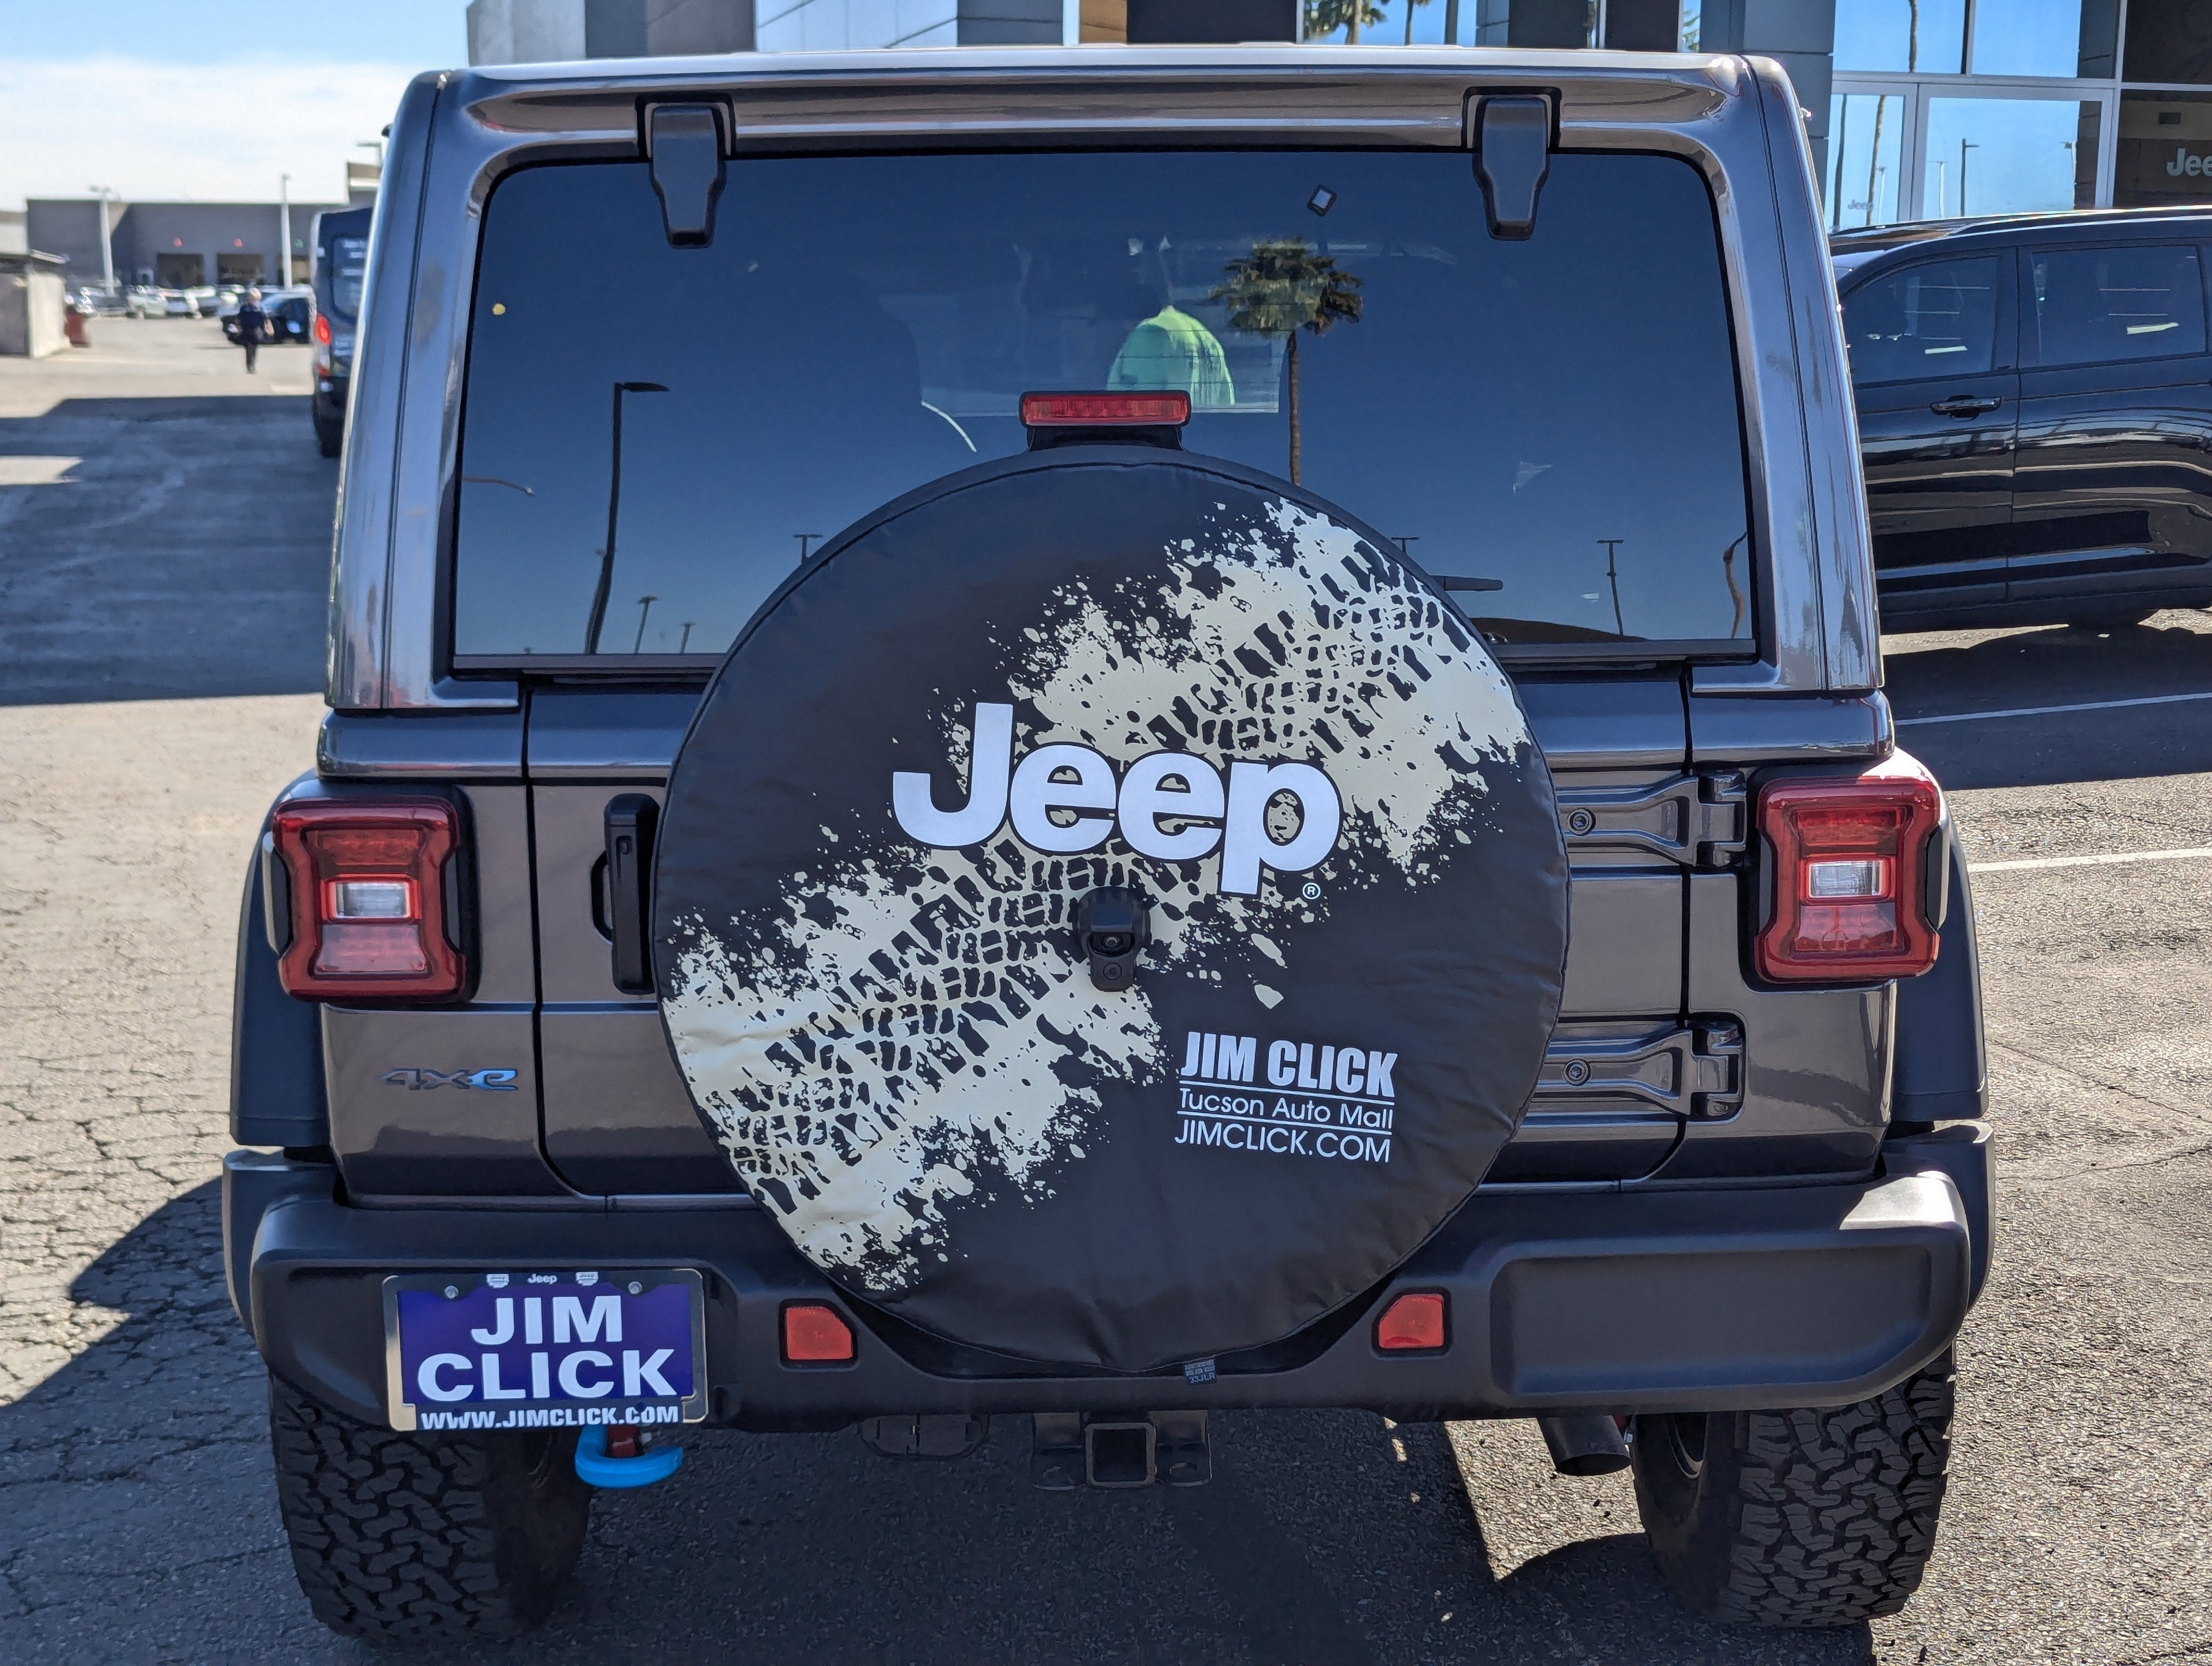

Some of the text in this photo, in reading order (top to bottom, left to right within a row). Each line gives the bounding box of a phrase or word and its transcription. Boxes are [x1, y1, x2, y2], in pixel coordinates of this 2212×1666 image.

[893, 702, 1340, 895] Jeep
[1180, 1031, 1398, 1098] JIM CLICK
[1179, 1088, 1393, 1129] Tucson Auto Mall
[1174, 1119, 1391, 1163] JIMCLICK.COM
[528, 1273, 557, 1284] Jeep
[471, 1295, 622, 1345] JIM
[417, 1349, 677, 1401] CLICK
[421, 1406, 679, 1430] WWW.JIMCLICK.COM
